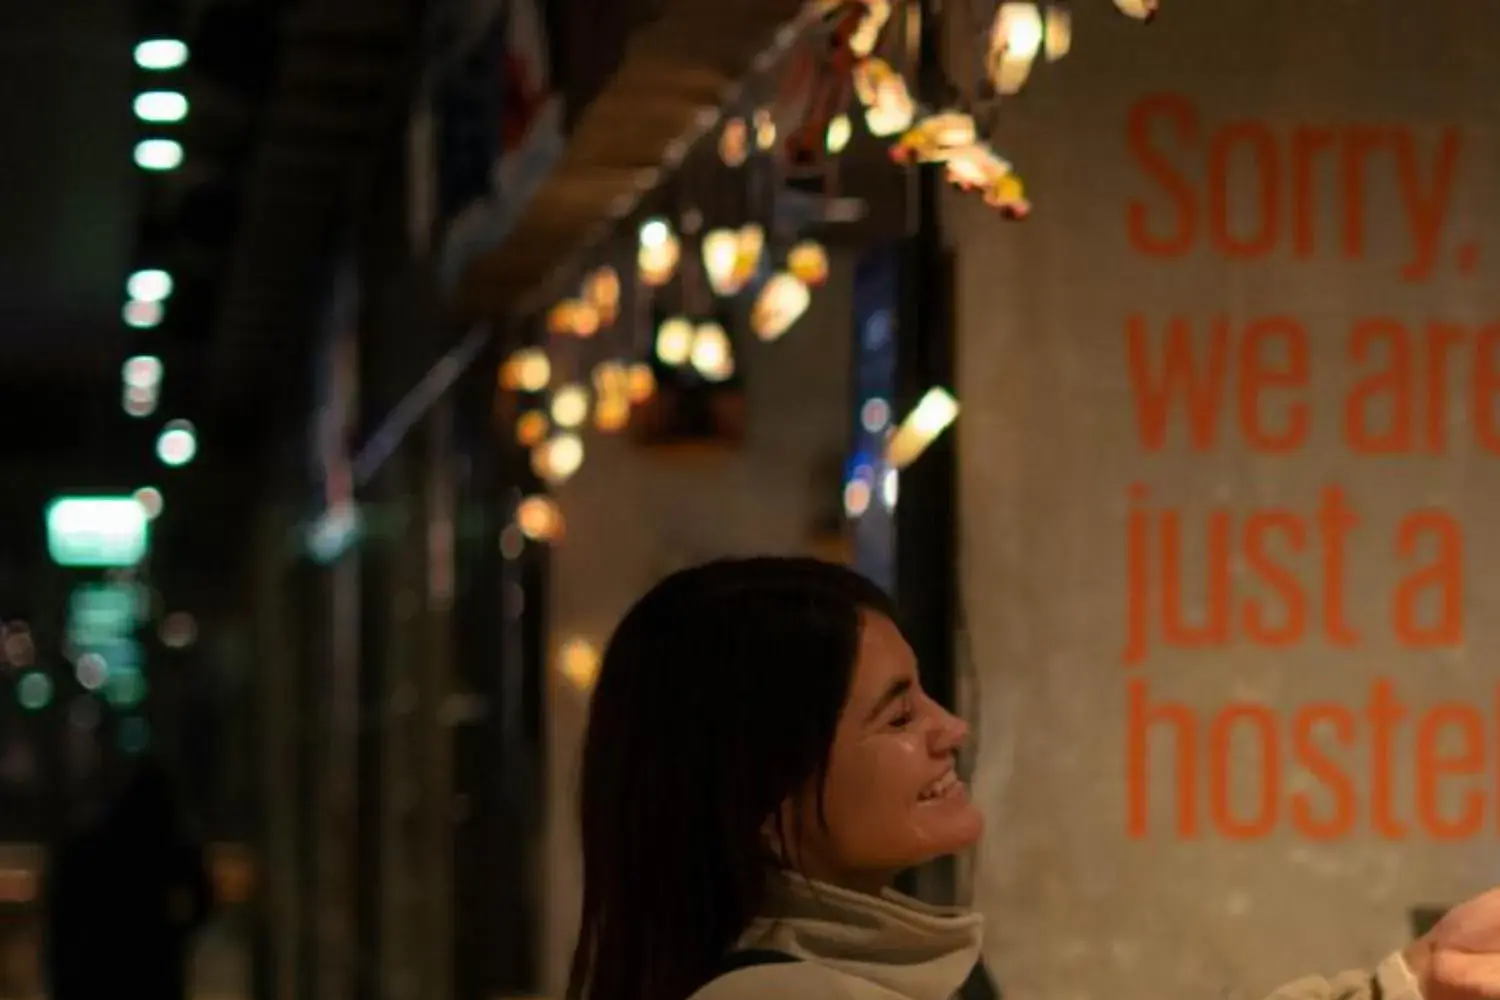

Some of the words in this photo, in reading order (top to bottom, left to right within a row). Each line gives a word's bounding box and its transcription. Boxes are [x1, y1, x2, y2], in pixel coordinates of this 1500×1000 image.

[1125, 315, 1311, 455] we
[1122, 483, 1363, 667] just
[1392, 509, 1465, 650] a
